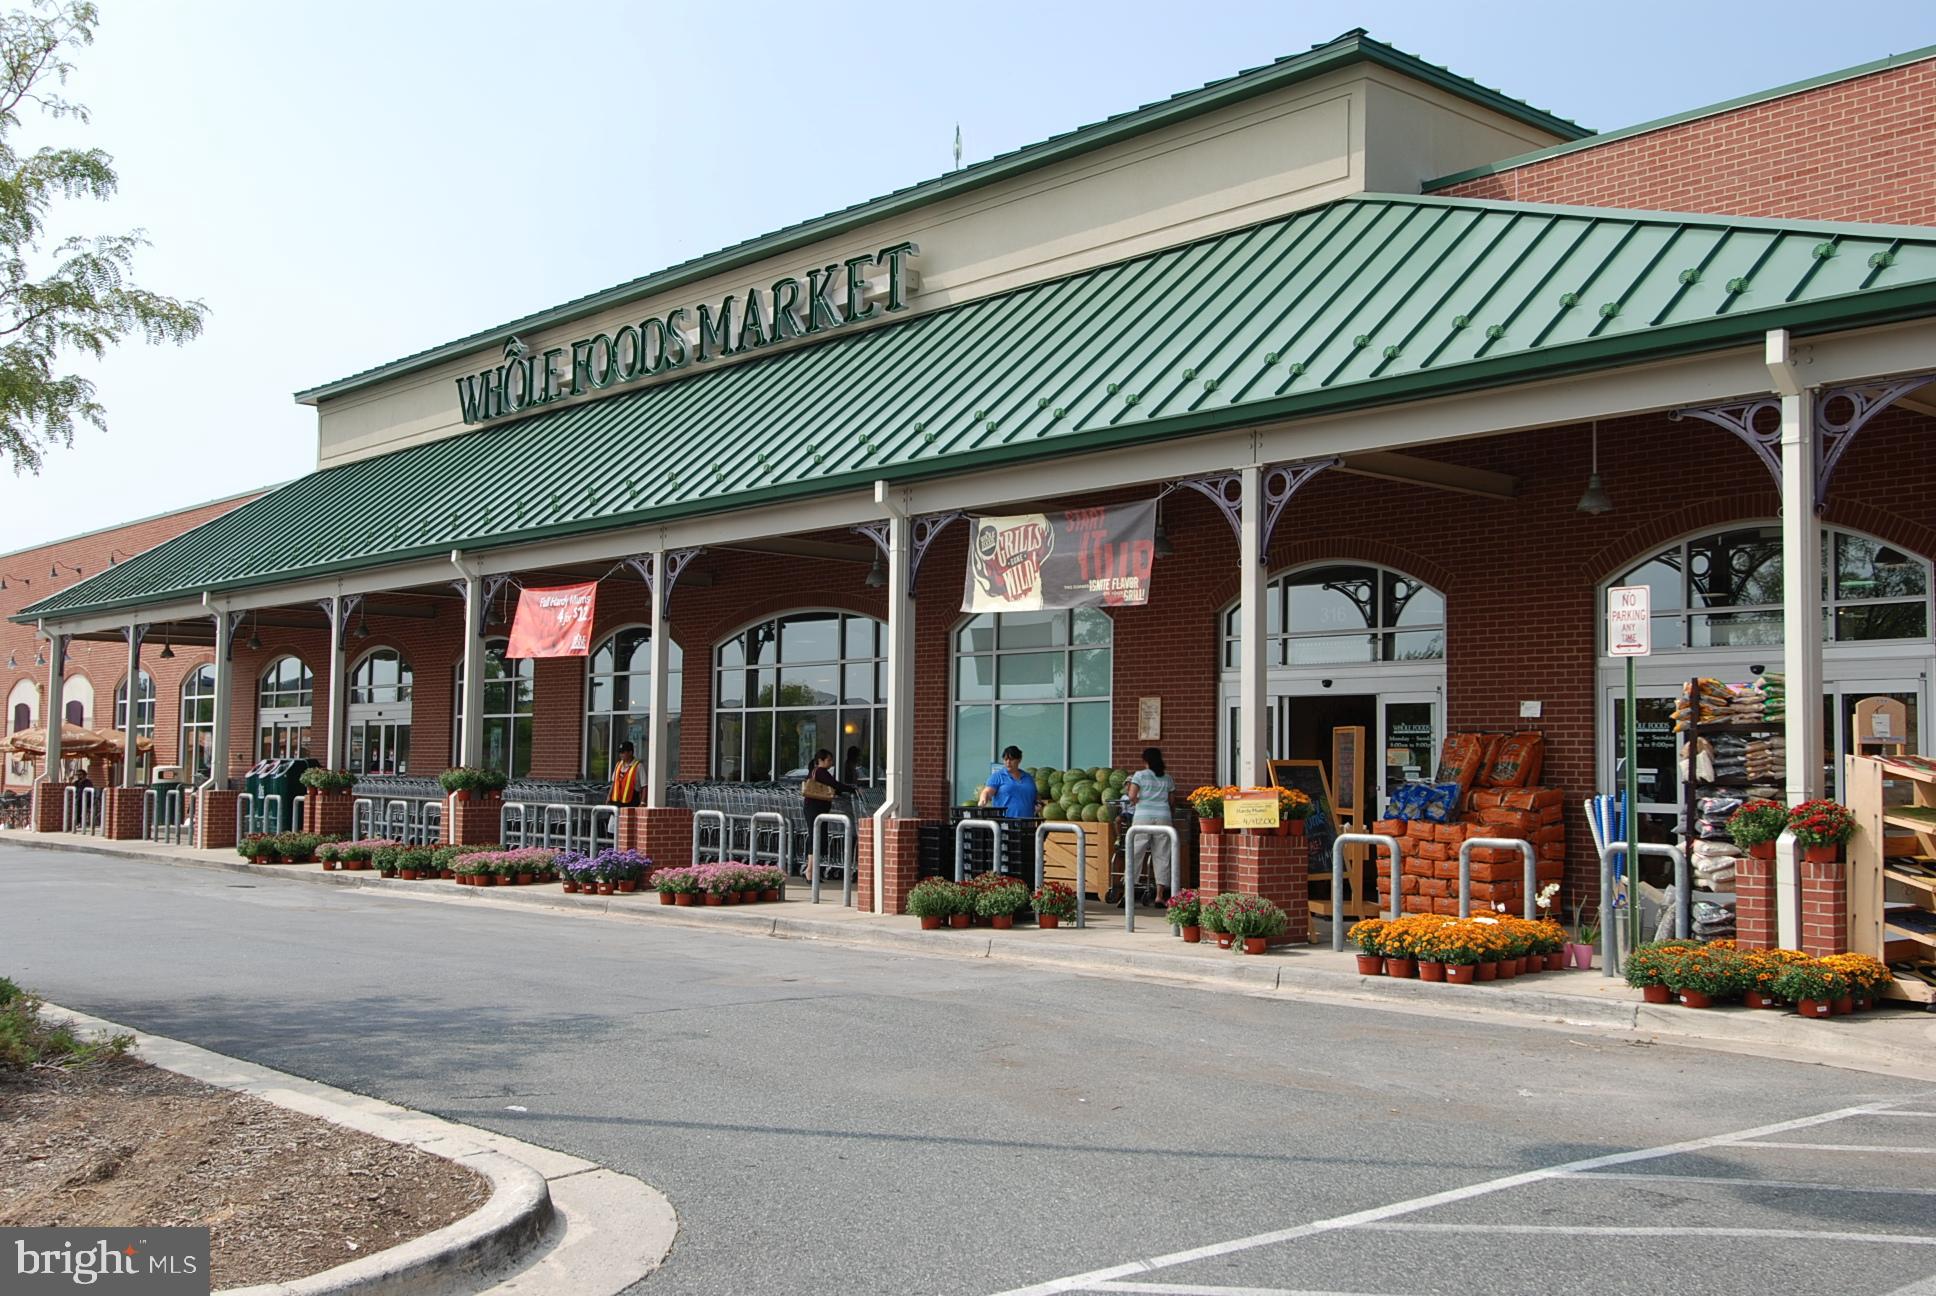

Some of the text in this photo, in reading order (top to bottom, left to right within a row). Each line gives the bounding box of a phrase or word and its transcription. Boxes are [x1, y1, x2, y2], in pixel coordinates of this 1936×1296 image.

[570, 306, 695, 394] FOODS
[695, 241, 921, 362] MARKET
[1065, 507, 1105, 533] START
[997, 524, 1042, 567] GRILLS
[1078, 529, 1108, 581] IT
[1002, 551, 1040, 600] WILD!
[1104, 538, 1154, 605] UP
[1089, 578, 1111, 592] IGNITE
[1111, 576, 1139, 590] FLAVOR
[550, 595, 569, 608] Hardy
[569, 594, 592, 605] Mums
[1123, 588, 1146, 602] GRILL!
[1622, 593, 1637, 606] NO
[557, 605, 590, 626] 4 for $12
[1612, 609, 1647, 622] PARKING
[1621, 624, 1636, 632] ANY
[1621, 633, 1637, 642] TIME
